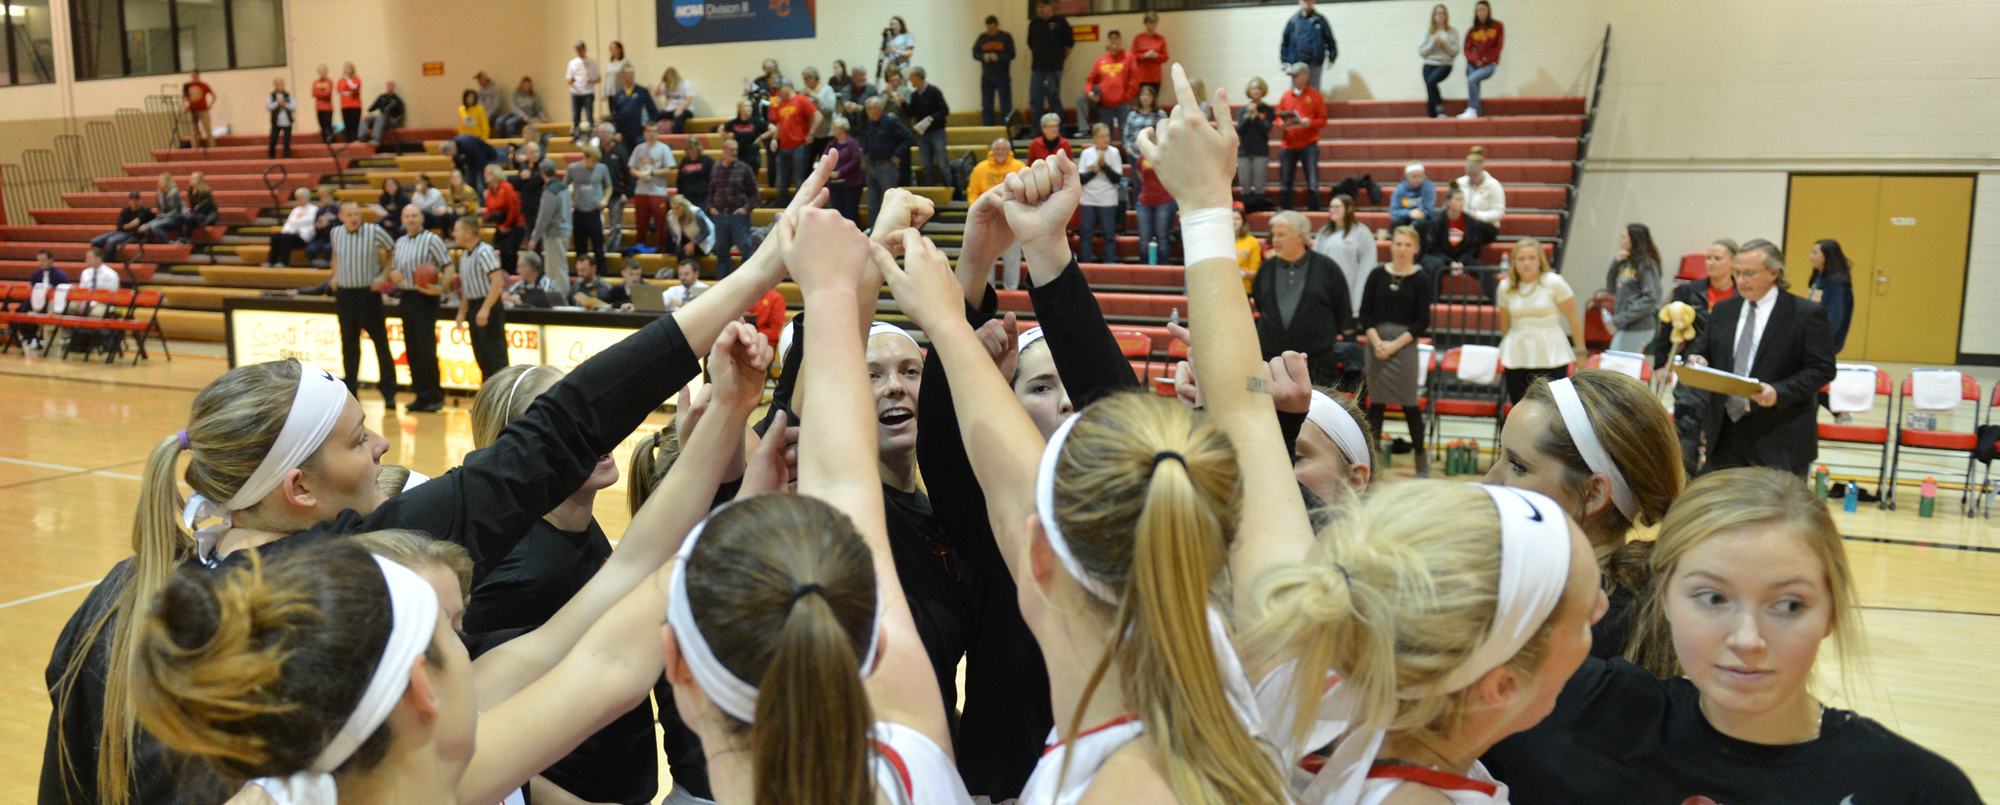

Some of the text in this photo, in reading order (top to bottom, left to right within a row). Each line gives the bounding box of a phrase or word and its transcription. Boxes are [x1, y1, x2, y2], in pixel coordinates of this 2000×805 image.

[705, 3, 740, 15] Division
[251, 322, 298, 351] Sports
[304, 318, 336, 355] Page
